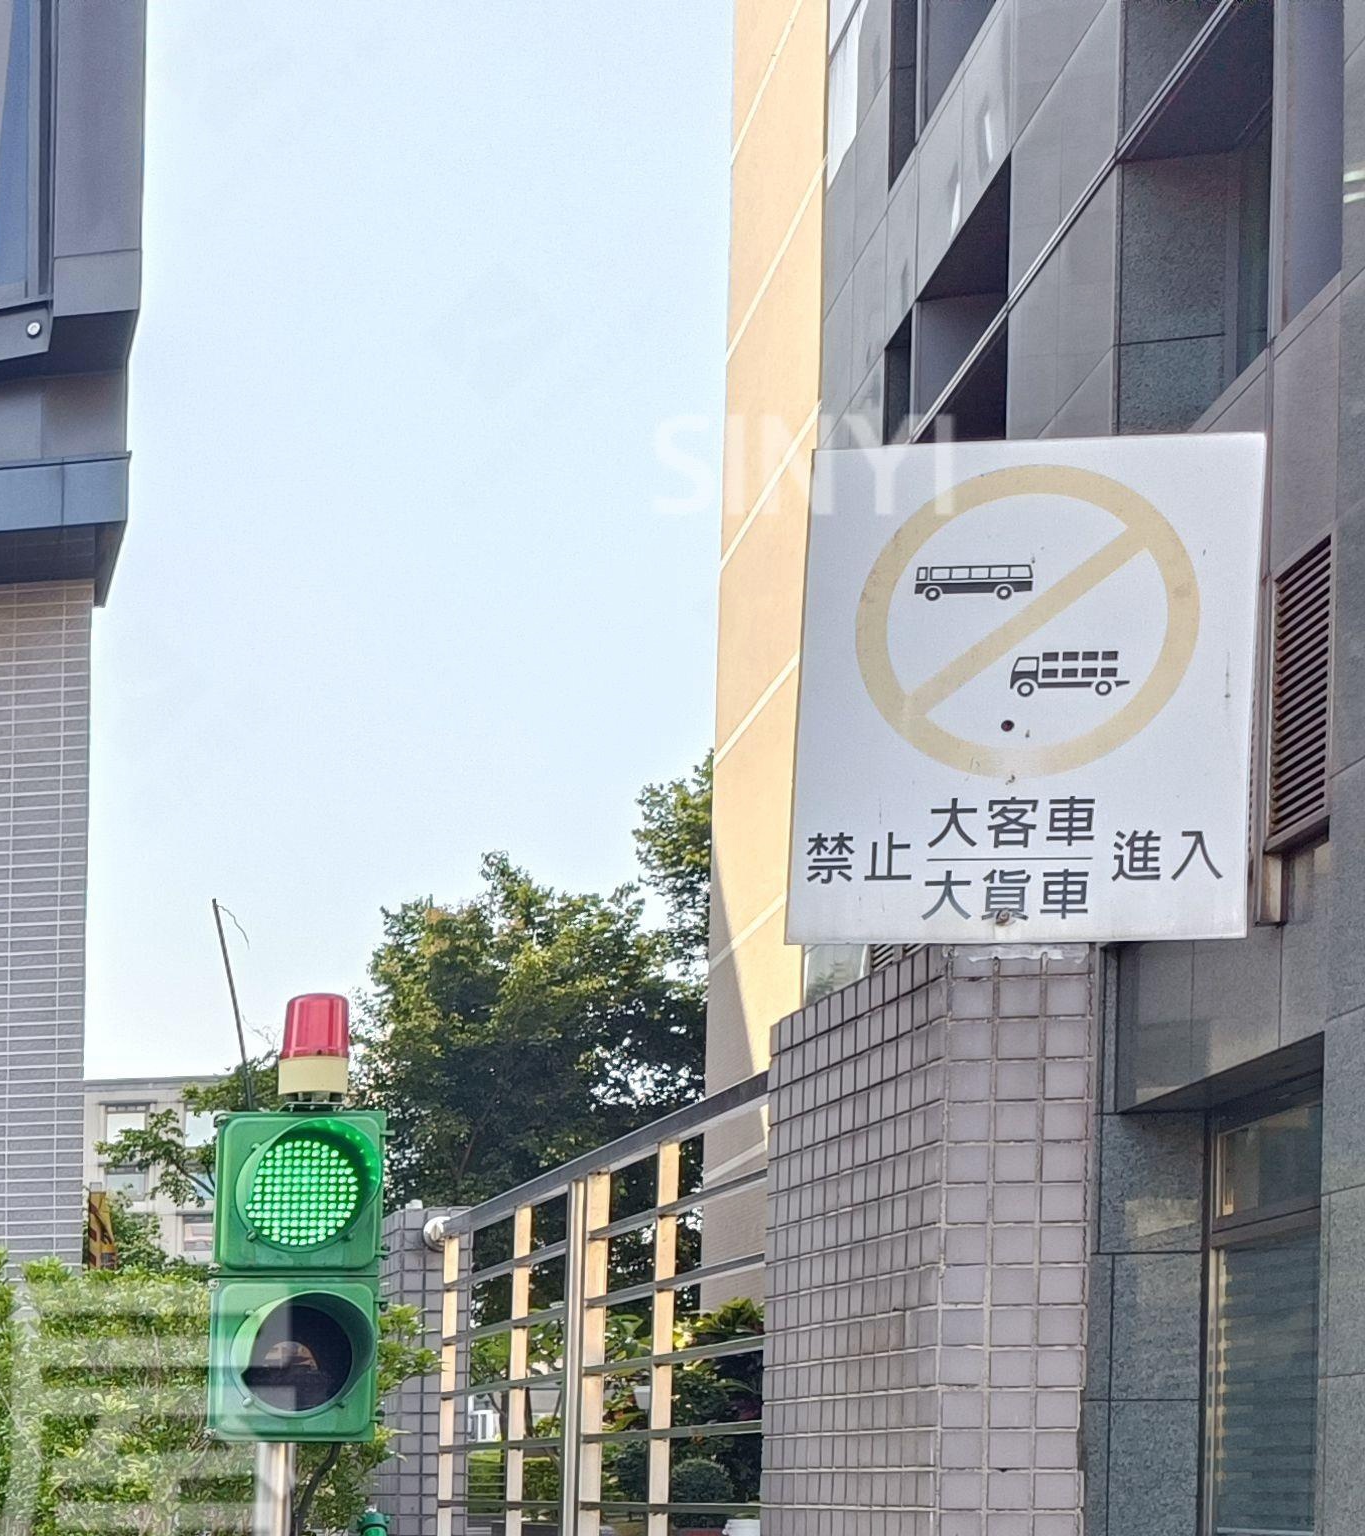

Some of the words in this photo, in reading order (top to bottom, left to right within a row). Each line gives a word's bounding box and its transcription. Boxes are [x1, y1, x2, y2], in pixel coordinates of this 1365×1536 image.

[927, 796, 1096, 848] 大客車
[806, 831, 912, 884] 禁止
[1111, 830, 1223, 881] 進入
[921, 868, 1089, 920] 大貨車
